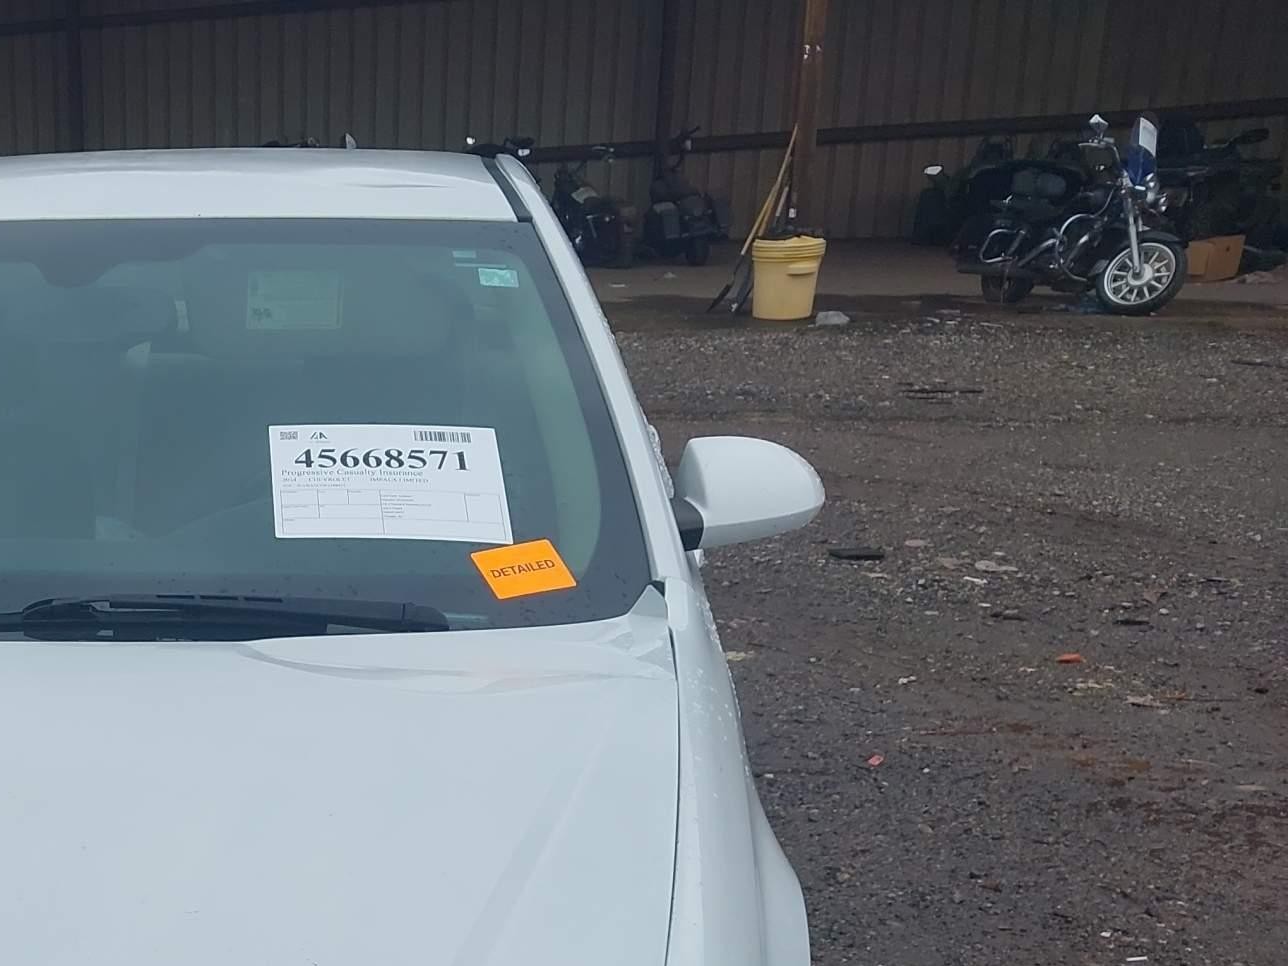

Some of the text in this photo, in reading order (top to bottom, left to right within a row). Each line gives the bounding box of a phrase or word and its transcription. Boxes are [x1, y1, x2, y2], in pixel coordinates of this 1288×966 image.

[294, 448, 471, 471] 45668571
[281, 469, 424, 478] Progressive Casualty Insurance
[490, 558, 556, 580] DETAILED
